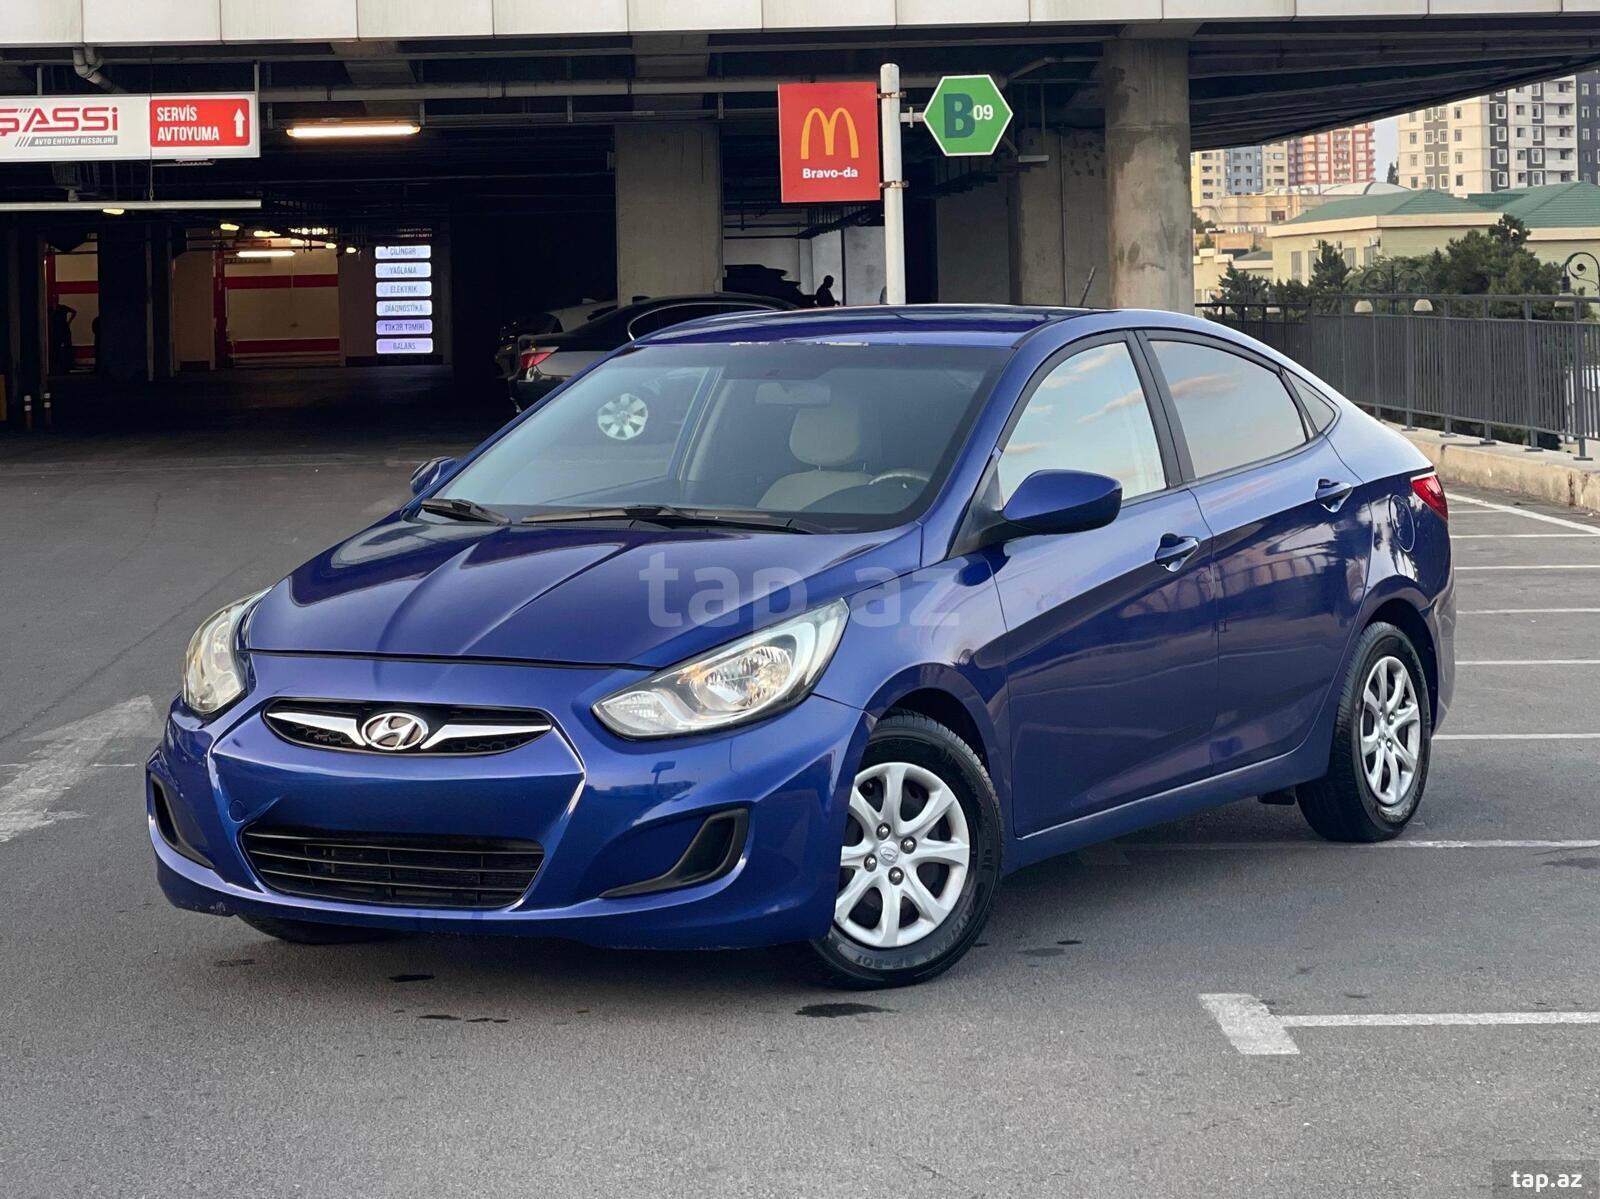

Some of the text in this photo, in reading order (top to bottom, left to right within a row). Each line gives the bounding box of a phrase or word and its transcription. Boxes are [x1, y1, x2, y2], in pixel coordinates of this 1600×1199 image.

[157, 104, 197, 122] SERVİS
[157, 126, 220, 142] AVTOYUMA
[802, 167, 859, 179] Bravo-da
[392, 341, 416, 350] BALANS
